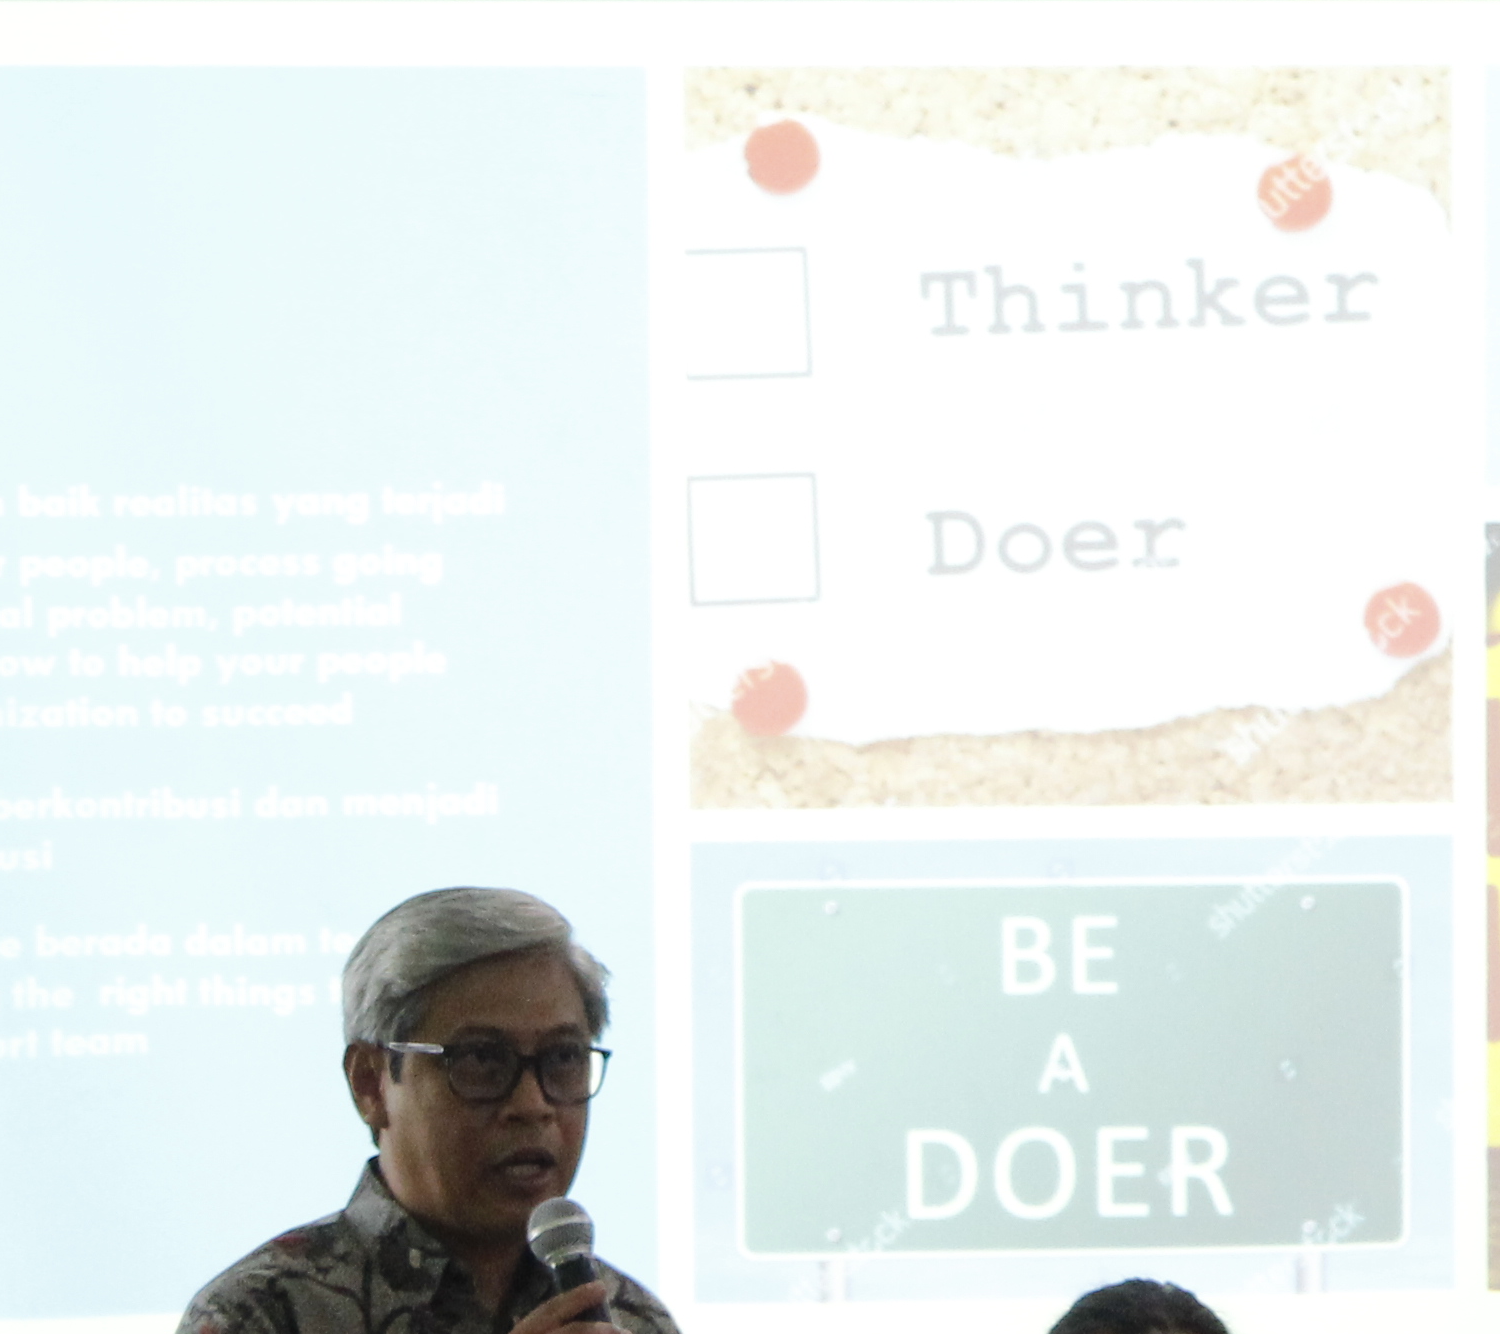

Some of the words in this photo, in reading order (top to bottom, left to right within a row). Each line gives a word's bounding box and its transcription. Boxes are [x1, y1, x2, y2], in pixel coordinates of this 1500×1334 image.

[918, 258, 1381, 338] Thinker
[17, 483, 101, 518] baik
[112, 483, 258, 518] realitas
[271, 491, 371, 526] yang
[381, 480, 507, 525] terjadi
[19, 543, 160, 588] people,
[175, 552, 322, 587] process
[331, 543, 444, 586] going
[924, 509, 1187, 577] Doer
[46, 595, 218, 638] problem,
[232, 591, 403, 637] potential
[67, 647, 106, 678] to
[117, 642, 203, 687] help
[215, 652, 306, 685] your
[316, 639, 448, 684] people
[149, 698, 189, 728] to
[201, 690, 354, 728] succeed
[253, 784, 330, 819] dan
[342, 781, 500, 826] menjadi
[36, 922, 173, 957] berada
[183, 922, 307, 957] dalam
[1000, 914, 1120, 997] BE
[11, 976, 75, 1009] the
[99, 973, 189, 1016] right
[197, 973, 318, 1017] things
[50, 1028, 150, 1057] team
[1036, 1032, 1091, 1095] A
[904, 1125, 1235, 1221] DOER
